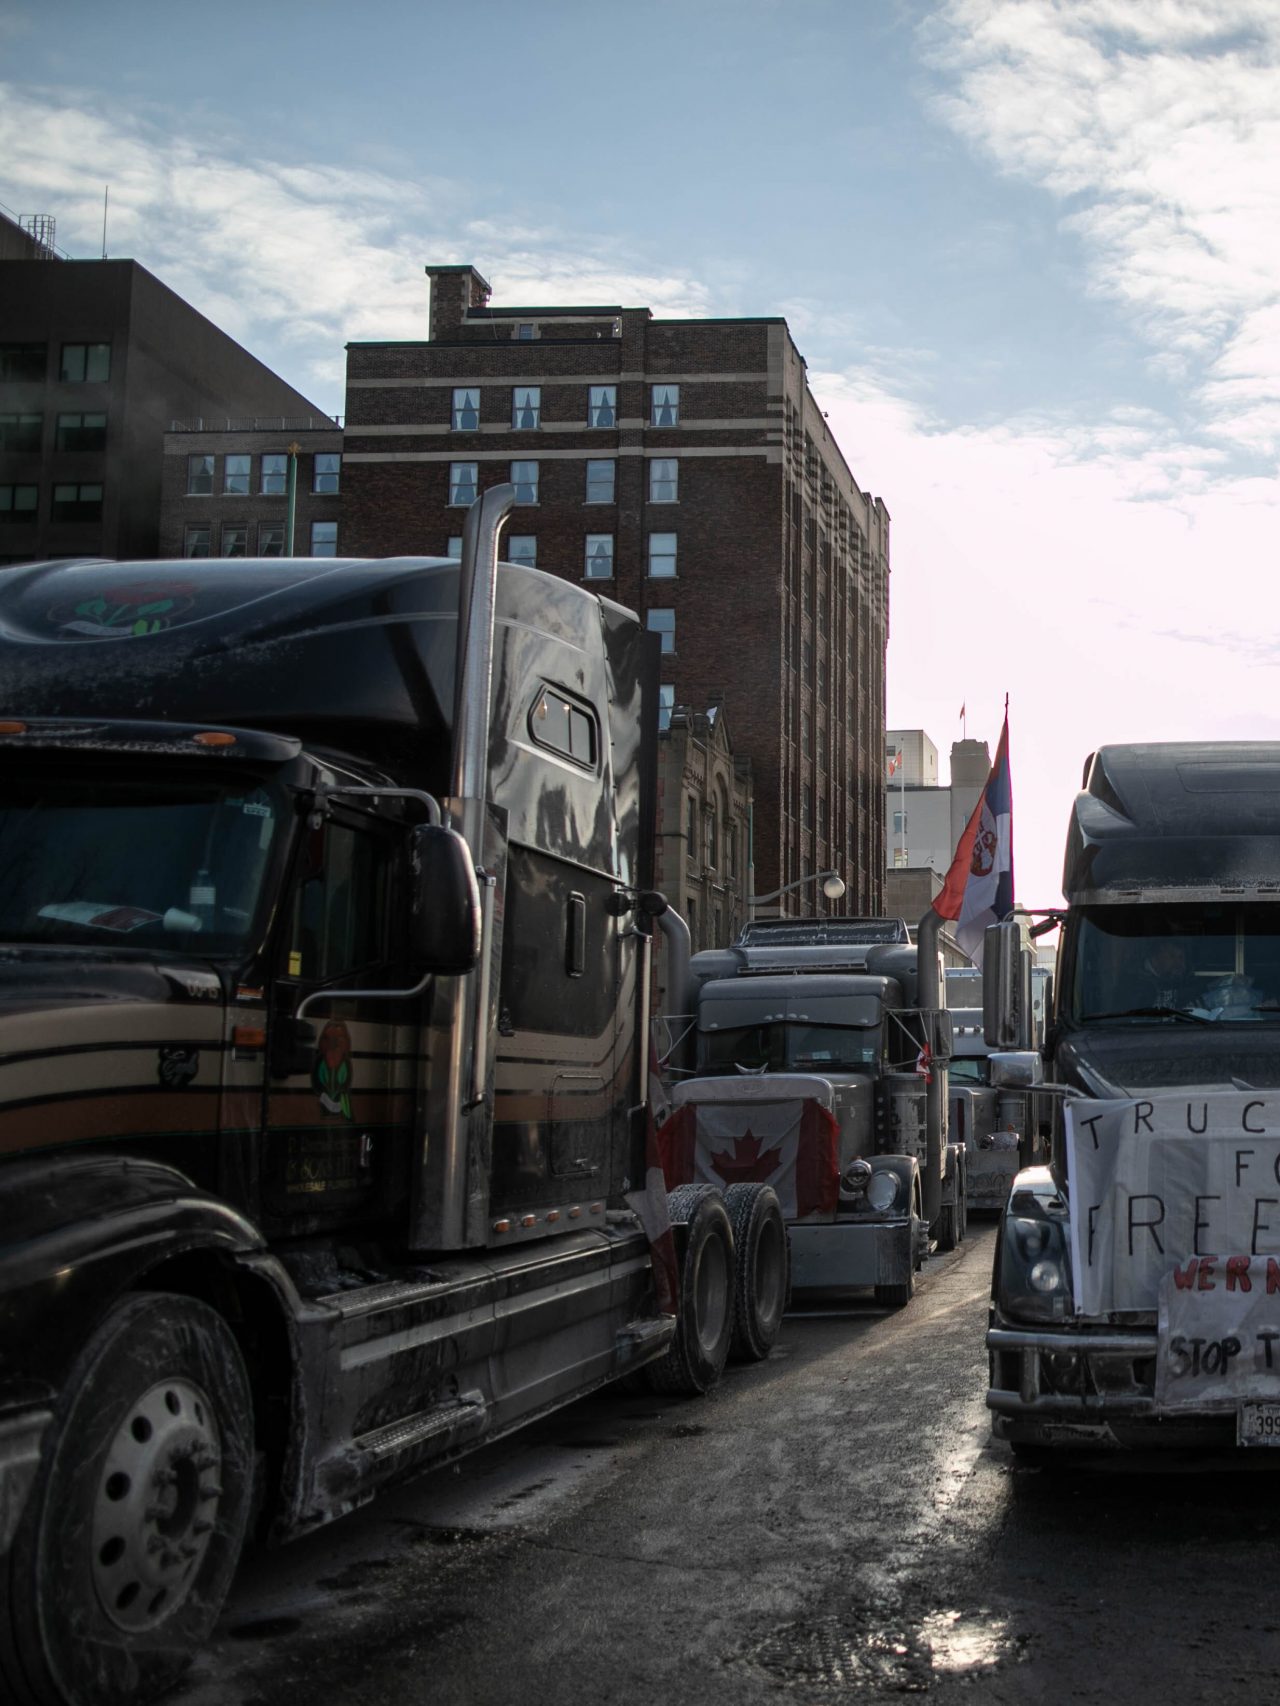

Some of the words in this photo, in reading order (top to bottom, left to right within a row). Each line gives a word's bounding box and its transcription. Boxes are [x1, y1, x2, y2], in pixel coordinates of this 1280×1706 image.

[1174, 1257, 1218, 1291] WE
[1226, 1256, 1252, 1292] R
[1169, 1336, 1241, 1378] STOP
